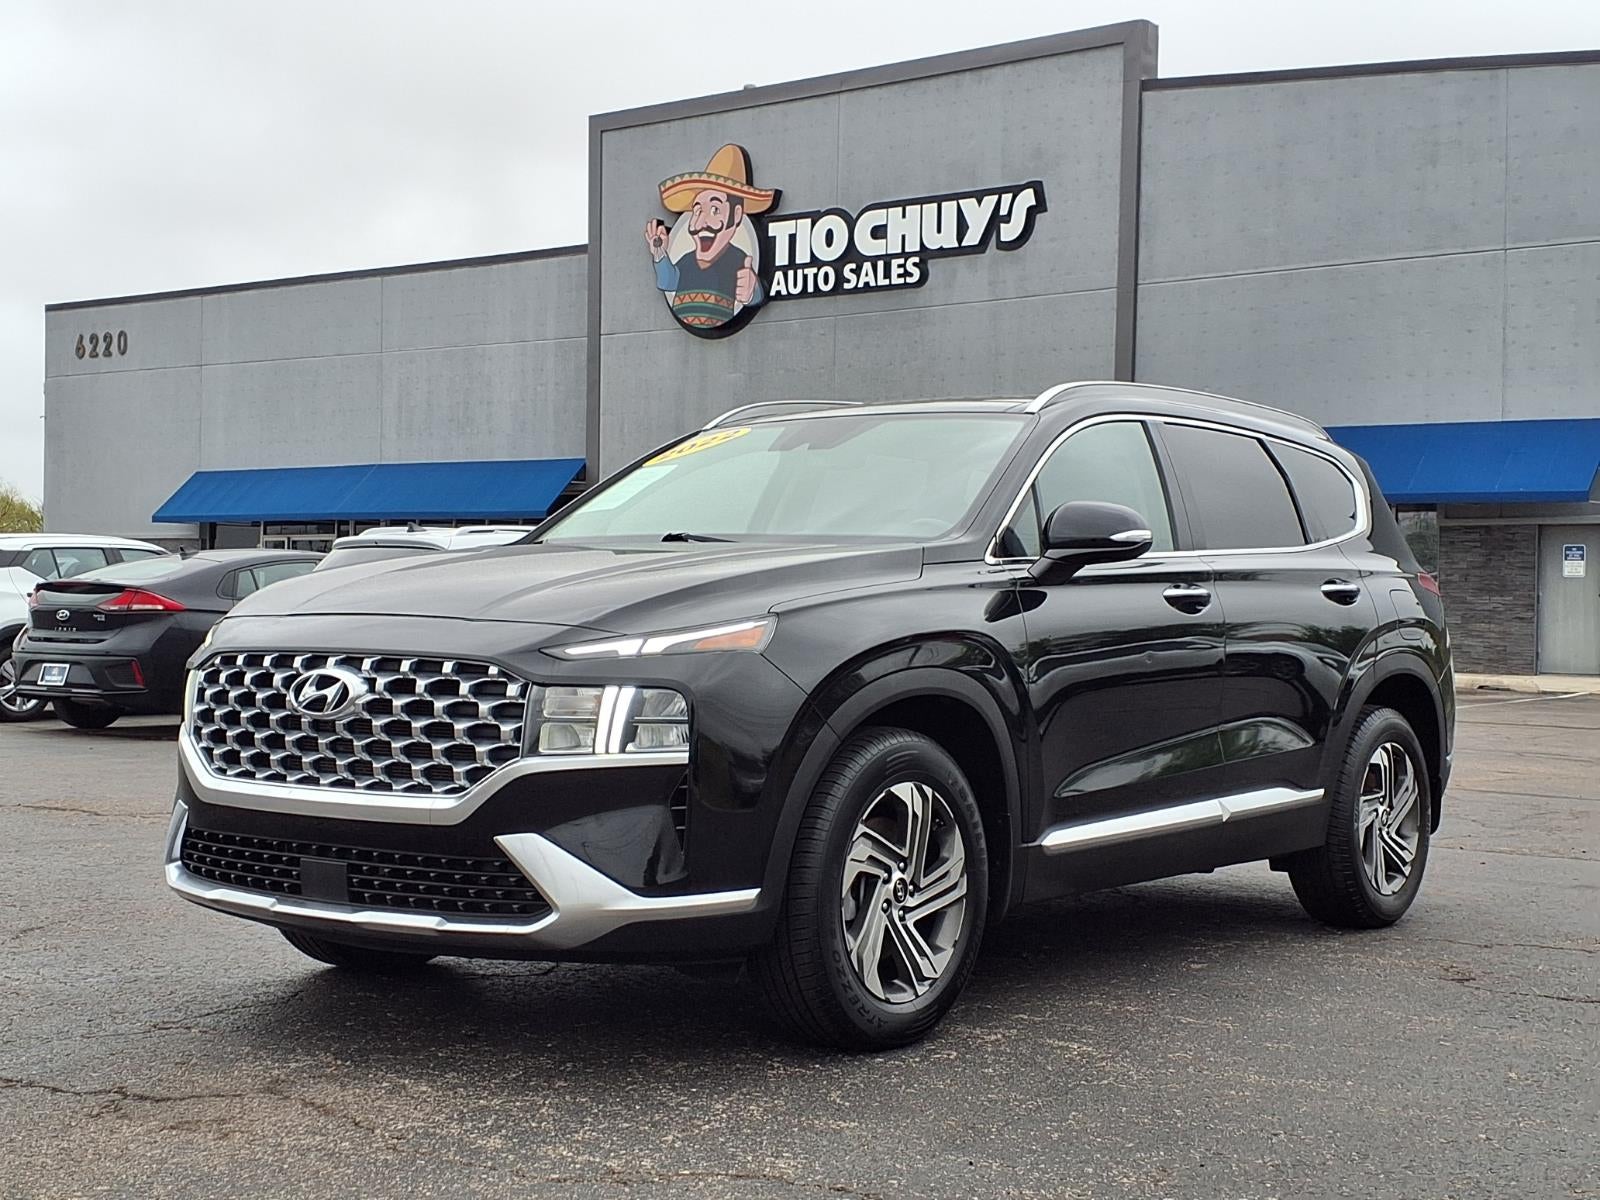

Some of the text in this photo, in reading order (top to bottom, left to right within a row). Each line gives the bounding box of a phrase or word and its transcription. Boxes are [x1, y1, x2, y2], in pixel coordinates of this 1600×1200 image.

[768, 187, 1037, 267] TIO CHUY'S
[769, 256, 921, 297] AUTO SALES
[75, 330, 128, 360] 6220
